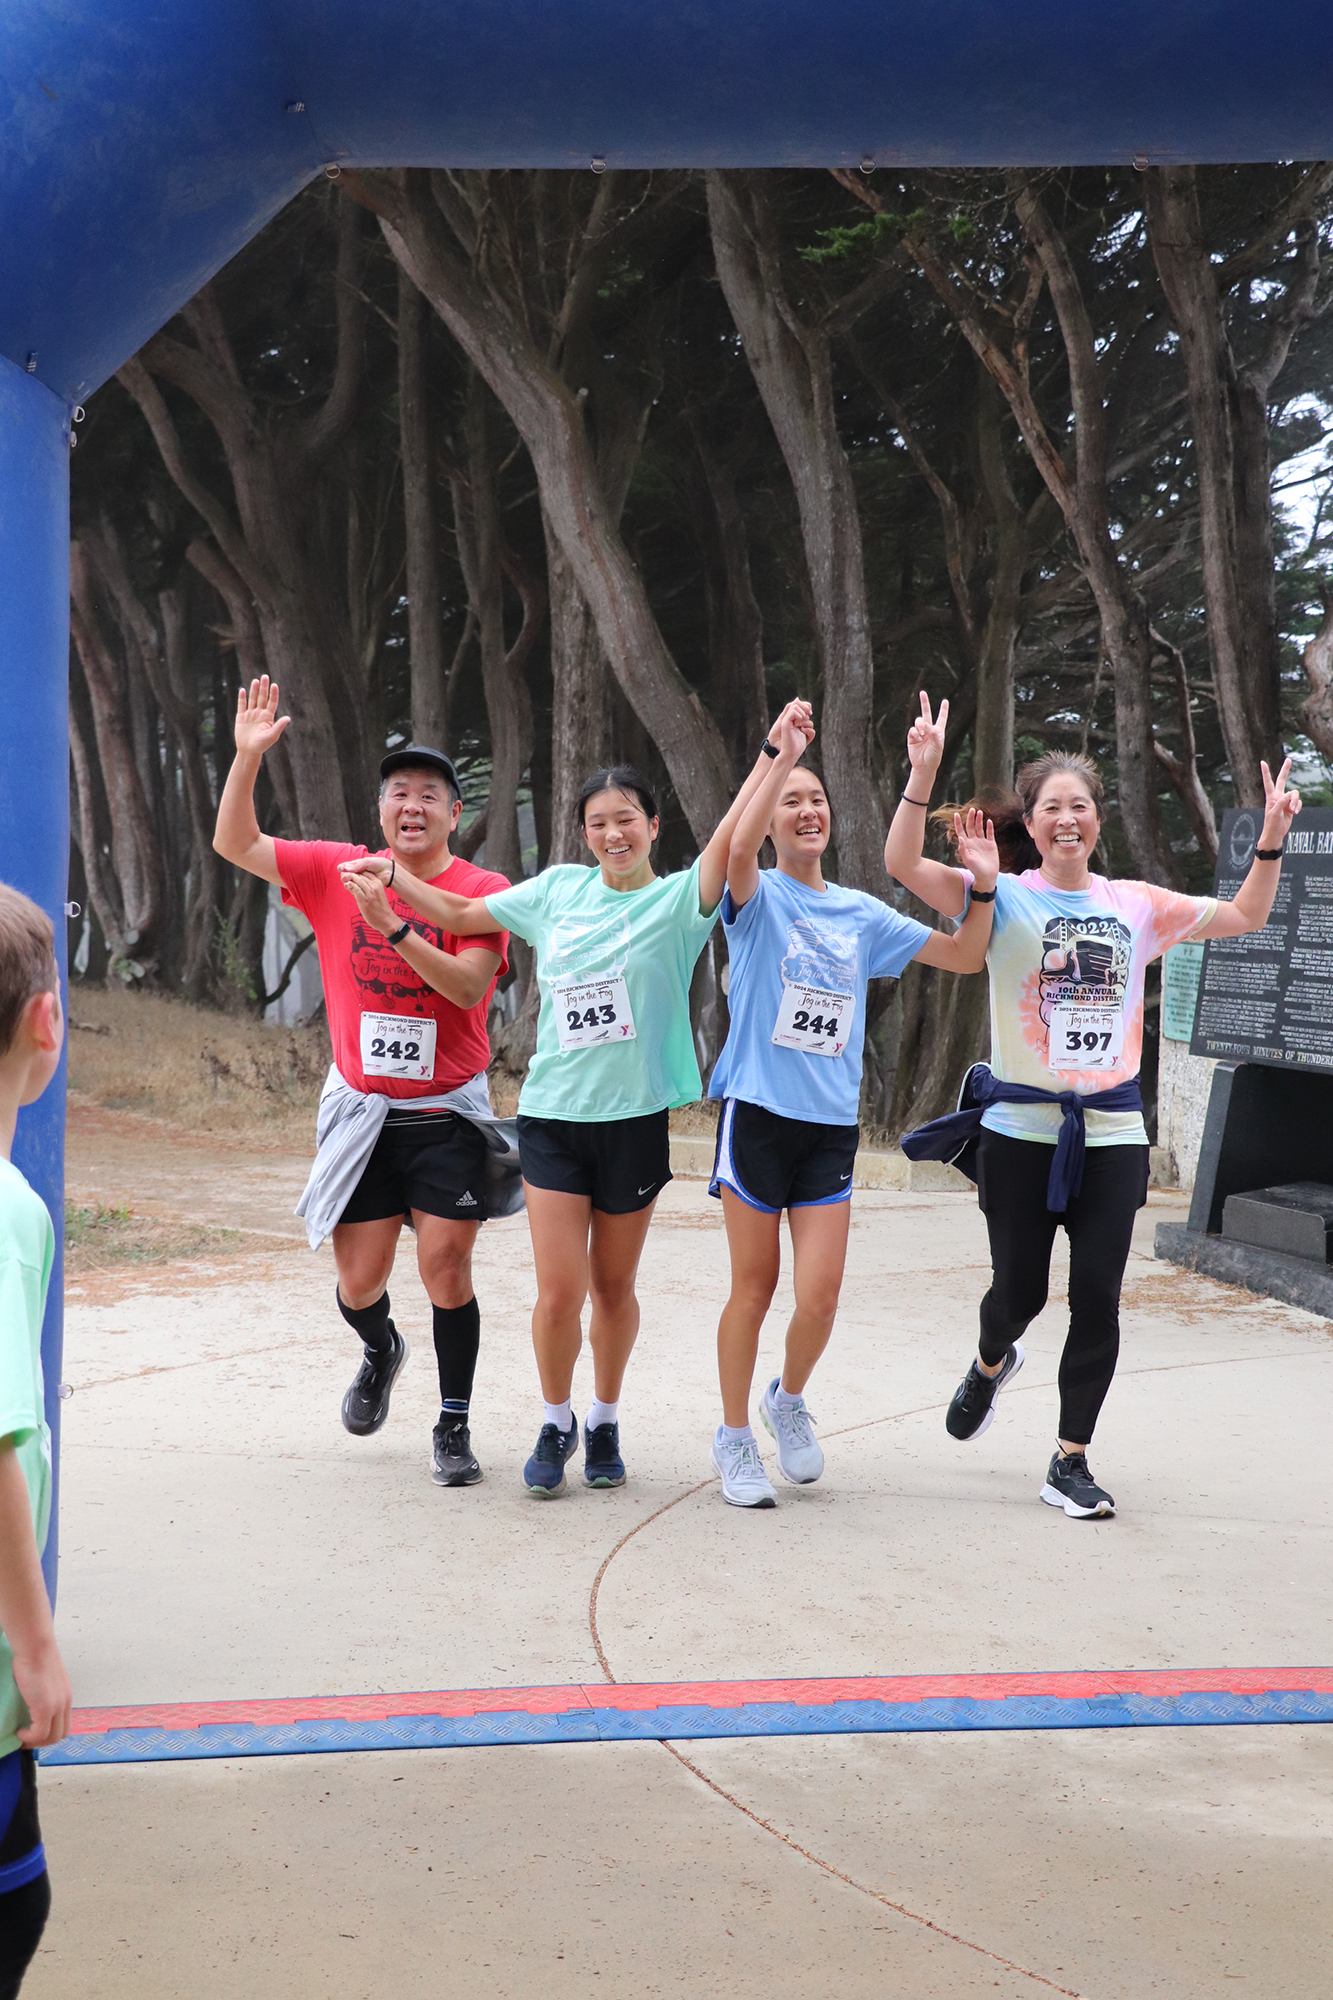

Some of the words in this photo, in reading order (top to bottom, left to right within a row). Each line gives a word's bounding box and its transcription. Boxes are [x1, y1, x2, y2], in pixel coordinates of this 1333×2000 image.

[1285, 831, 1315, 854] NAVAL
[361, 958, 380, 977] Jog
[383, 964, 392, 974] in
[394, 964, 408, 976] the
[793, 962, 812, 982] Jog
[813, 969, 822, 979] in
[823, 971, 835, 985] the
[564, 993, 577, 1008] Jog
[578, 993, 586, 1001] in
[585, 990, 597, 1000] the
[596, 986, 613, 1001] Fog
[566, 984, 595, 992] RICHMOND
[807, 987, 832, 998] RICHMOND
[833, 993, 852, 1001] DISTRICT
[1046, 992, 1091, 1002] RICHMOND
[1058, 986, 1079, 994] 10th
[1081, 987, 1117, 995] ANNUAL
[798, 992, 814, 1010] Jog
[815, 997, 821, 1006] in
[821, 998, 830, 1008] the
[831, 999, 843, 1016] Fog
[380, 1015, 407, 1023] RICHMOND
[566, 1004, 616, 1030] 243
[792, 1010, 838, 1037] 244
[1066, 1013, 1082, 1029] Jog
[1083, 1015, 1089, 1024] in
[1090, 1014, 1100, 1024] the
[1100, 1014, 1113, 1029] Fog
[373, 1021, 387, 1036] Jog
[389, 1024, 395, 1033] in
[396, 1024, 406, 1034] the
[407, 1025, 423, 1040] Fog
[371, 1038, 420, 1061] 242
[1066, 1031, 1112, 1051] 397
[1206, 1040, 1250, 1055] TWENTY-FOUR
[1253, 1046, 1283, 1060] MINUTES
[1285, 1050, 1296, 1061] OF
